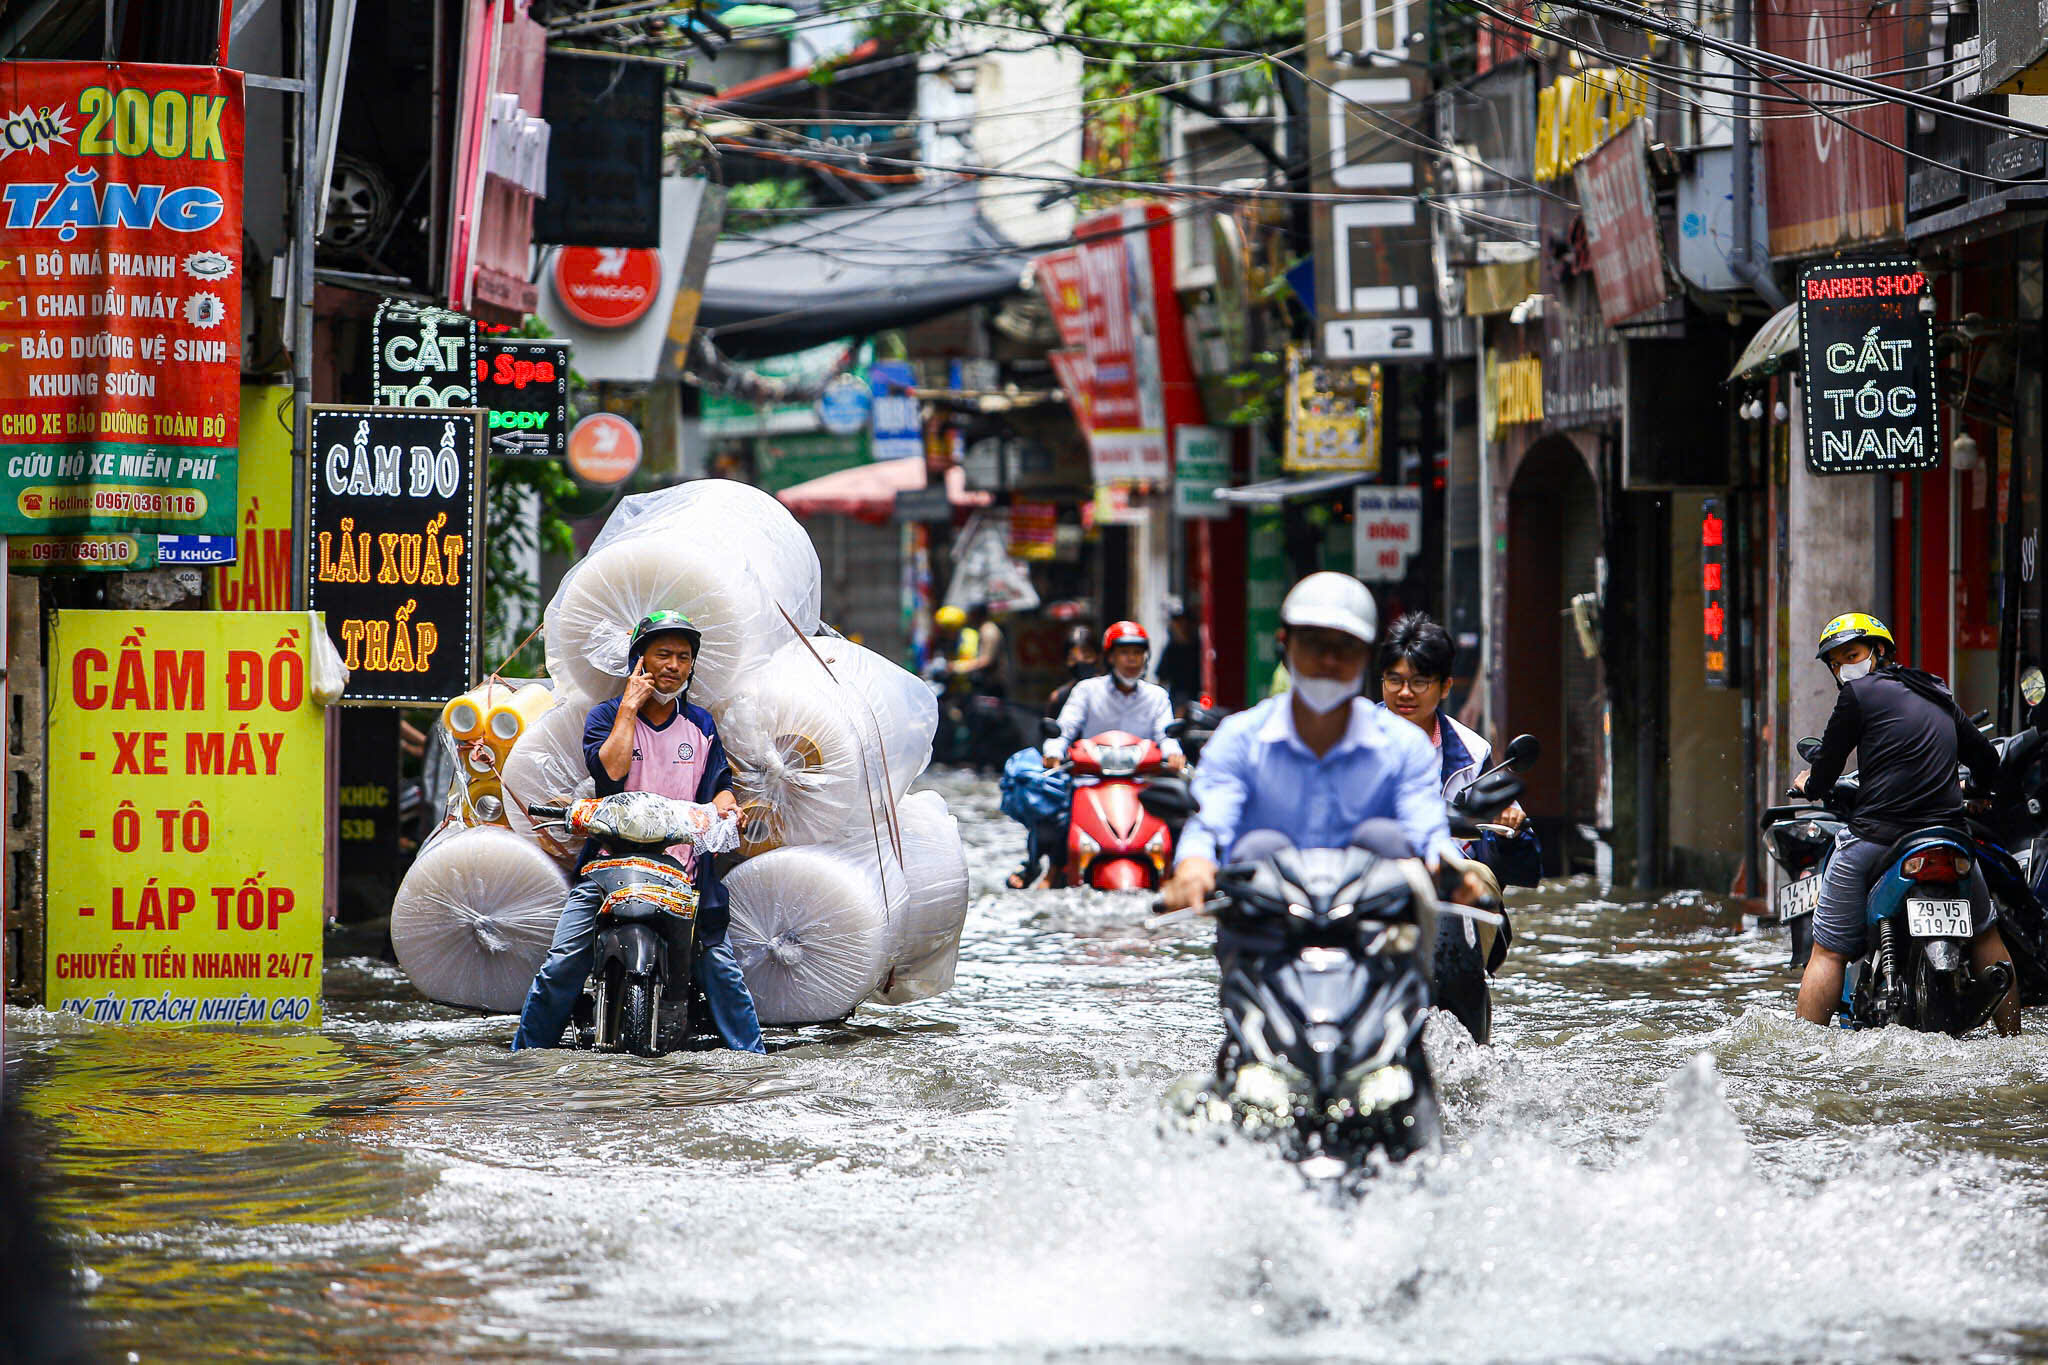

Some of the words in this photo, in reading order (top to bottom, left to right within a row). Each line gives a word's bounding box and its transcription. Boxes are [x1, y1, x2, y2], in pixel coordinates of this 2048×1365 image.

[4, 107, 60, 150] Chỉ
[79, 87, 229, 162] 200K
[5, 165, 225, 242] TẶNG
[17, 256, 27, 276] 1
[36, 250, 63, 281] BỘ
[70, 252, 103, 276] MÁ
[108, 254, 176, 278] PHANH
[17, 297, 27, 317] 1
[37, 296, 85, 317] CHAI
[91, 286, 125, 318] DẦU
[131, 292, 179, 319] MÁY
[1807, 277, 1875, 300] BARBER
[1876, 272, 1925, 297] SHOP
[21, 330, 65, 361] BẢO
[70, 331, 135, 360] DƯỠNG
[140, 334, 167, 364] VỆ
[174, 339, 227, 364] SINH
[1825, 325, 1913, 375] CẮT
[29, 372, 99, 398] KHUNG
[105, 369, 156, 397] SƯỜN
[493, 353, 557, 390] Spa
[1823, 379, 1917, 421] TÓC
[2, 413, 37, 435] CHO
[41, 413, 62, 435] XE
[66, 406, 96, 435] BẢO
[101, 408, 149, 436] DƯỠNG
[154, 411, 198, 438] TOÀN
[203, 412, 227, 443] BỘ
[488, 410, 550, 429] BODY
[326, 419, 402, 496] CẦM
[409, 421, 460, 498] ĐỒ
[1821, 426, 1924, 462] NAM
[7, 452, 53, 478] CỨU
[57, 450, 85, 481] HỘ
[88, 453, 115, 476] XE
[119, 449, 171, 480] MIỄN
[177, 454, 218, 480] PHÍ
[49, 496, 93, 511] Hotline:
[95, 490, 130, 511] 0967
[133, 492, 162, 512] 036
[165, 495, 197, 513] 116
[101, 541, 129, 560] 116
[181, 548, 222, 560] KHÚC
[318, 517, 372, 583] LÃI
[377, 511, 464, 585] XUẤT
[342, 598, 438, 672] THẤP
[72, 627, 205, 711] CẦM
[226, 629, 304, 712] ĐỒ
[112, 732, 169, 775] XE
[186, 722, 285, 775] MÁY
[112, 800, 141, 853] Ô
[156, 800, 210, 853] TÔ
[112, 878, 196, 930] LÁP
[211, 871, 295, 930] TỐP
[1783, 891, 1820, 918] 121.4
[1917, 902, 1960, 918] 29-V5
[1913, 917, 1968, 935] 519.70
[56, 943, 136, 979] CHUYỂN
[193, 952, 261, 979] NHANH
[267, 953, 314, 978] 24/7
[92, 991, 126, 1022] TÍN
[130, 991, 198, 1022] TRÁCH
[199, 992, 265, 1027] NHIỆM
[270, 997, 311, 1022] CAO
